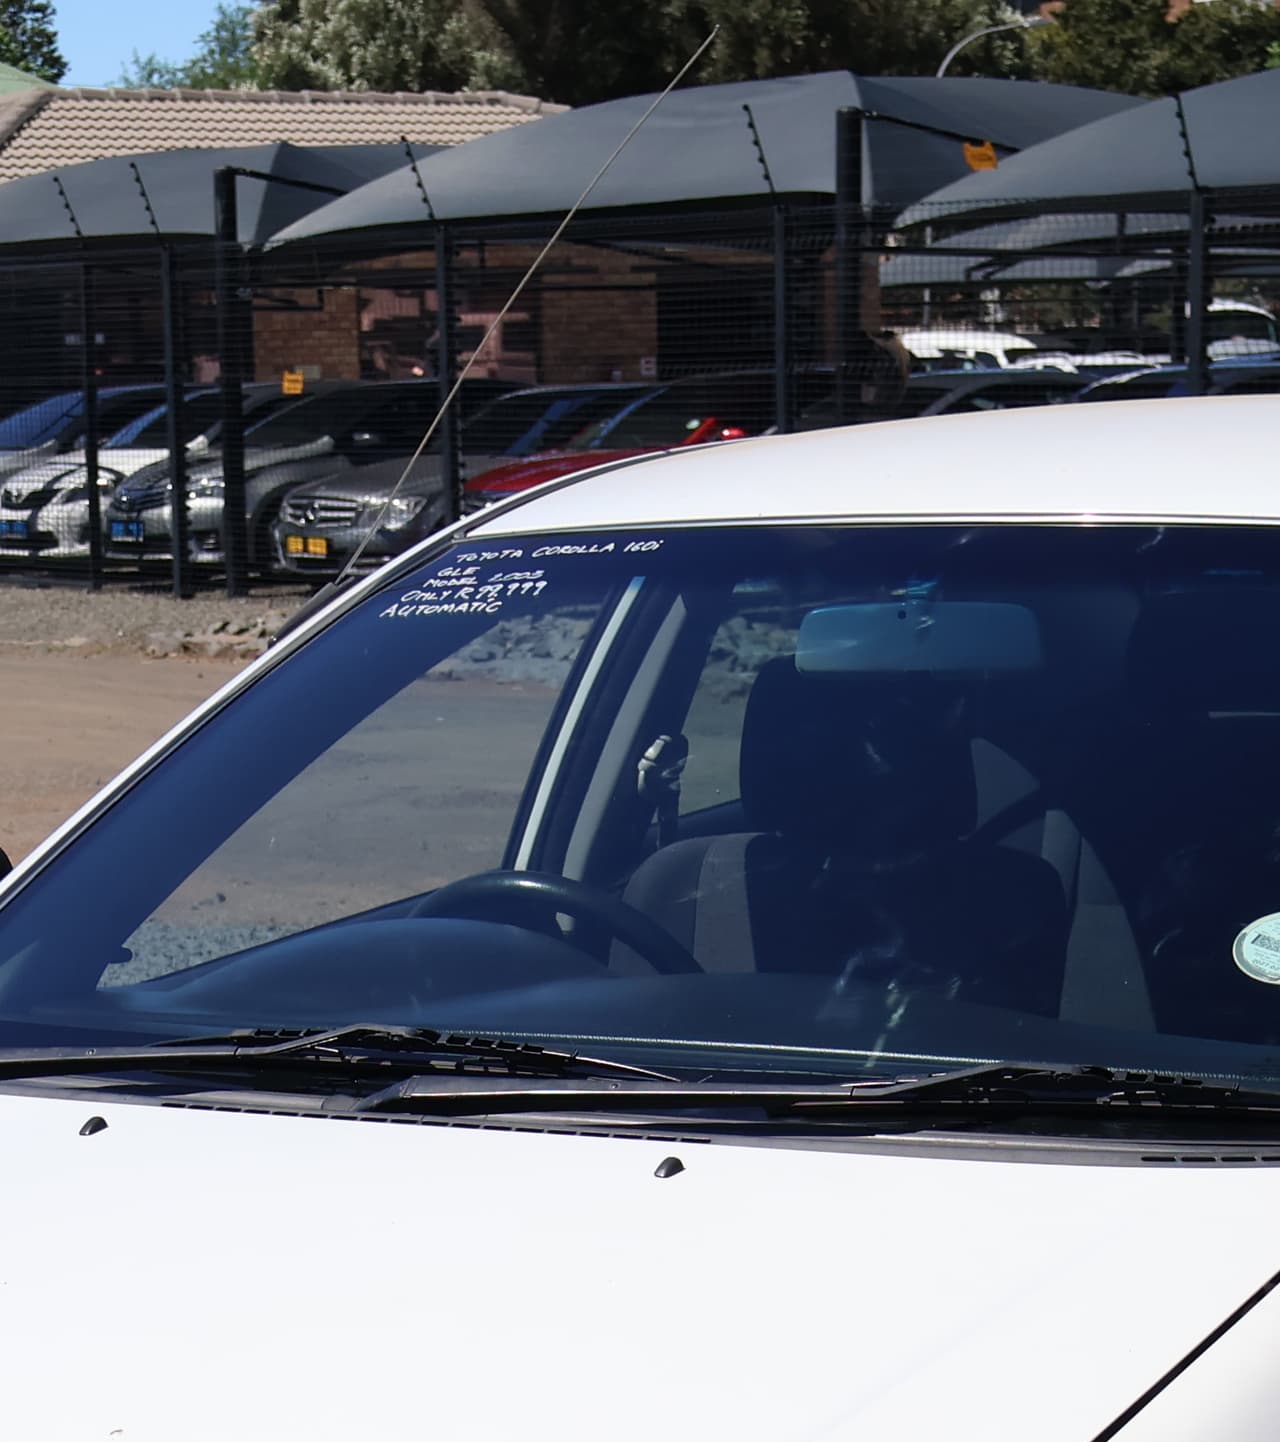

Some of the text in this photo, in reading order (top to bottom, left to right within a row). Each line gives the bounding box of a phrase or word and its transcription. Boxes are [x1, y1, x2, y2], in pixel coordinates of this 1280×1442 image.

[456, 549, 524, 564] TOYOTA
[531, 542, 616, 558] COROLLA
[437, 566, 481, 577] GLE
[422, 576, 478, 588] MODEL
[400, 590, 452, 602] ONLY
[379, 601, 503, 618] AUTOMATIC
